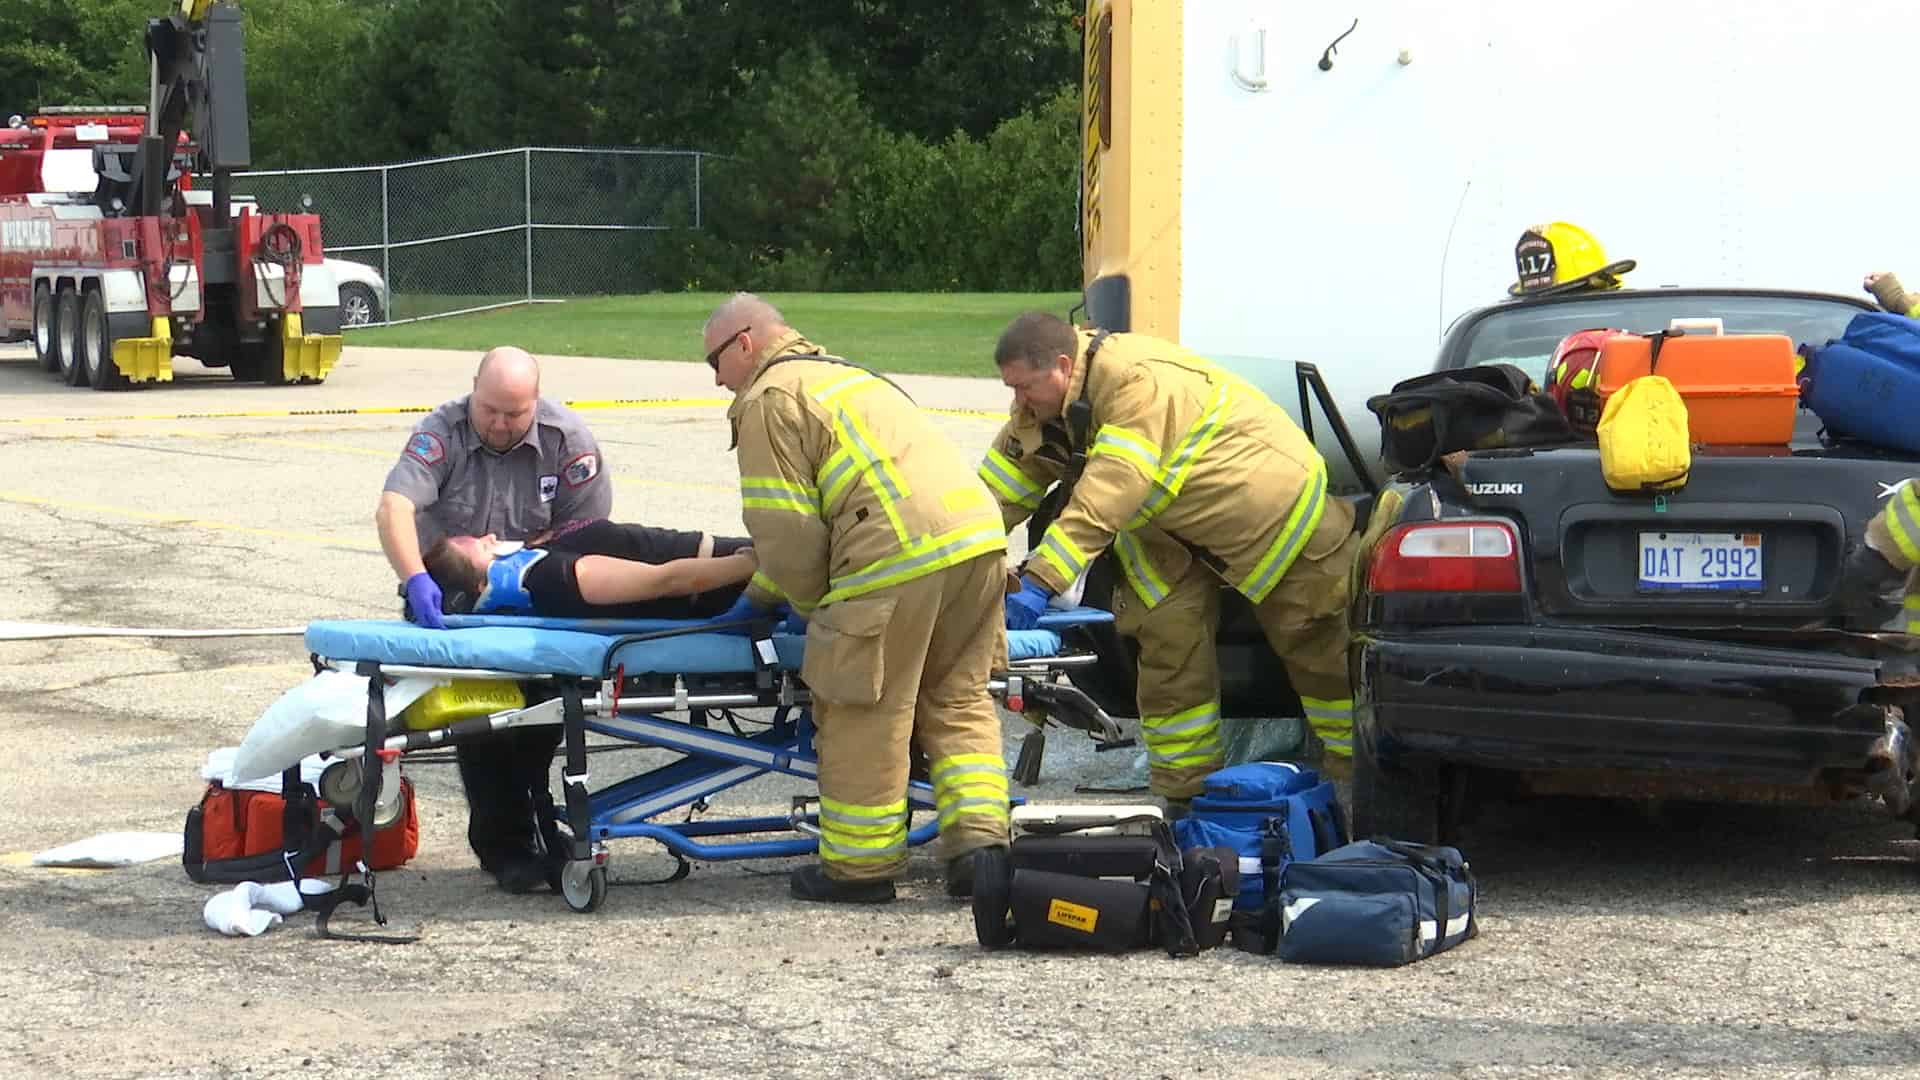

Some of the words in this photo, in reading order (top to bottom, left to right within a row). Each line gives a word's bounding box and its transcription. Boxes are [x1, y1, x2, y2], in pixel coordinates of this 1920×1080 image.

[1519, 253, 1552, 276] 117
[1644, 547, 1684, 577] DAT
[1701, 547, 1757, 577] 2992
